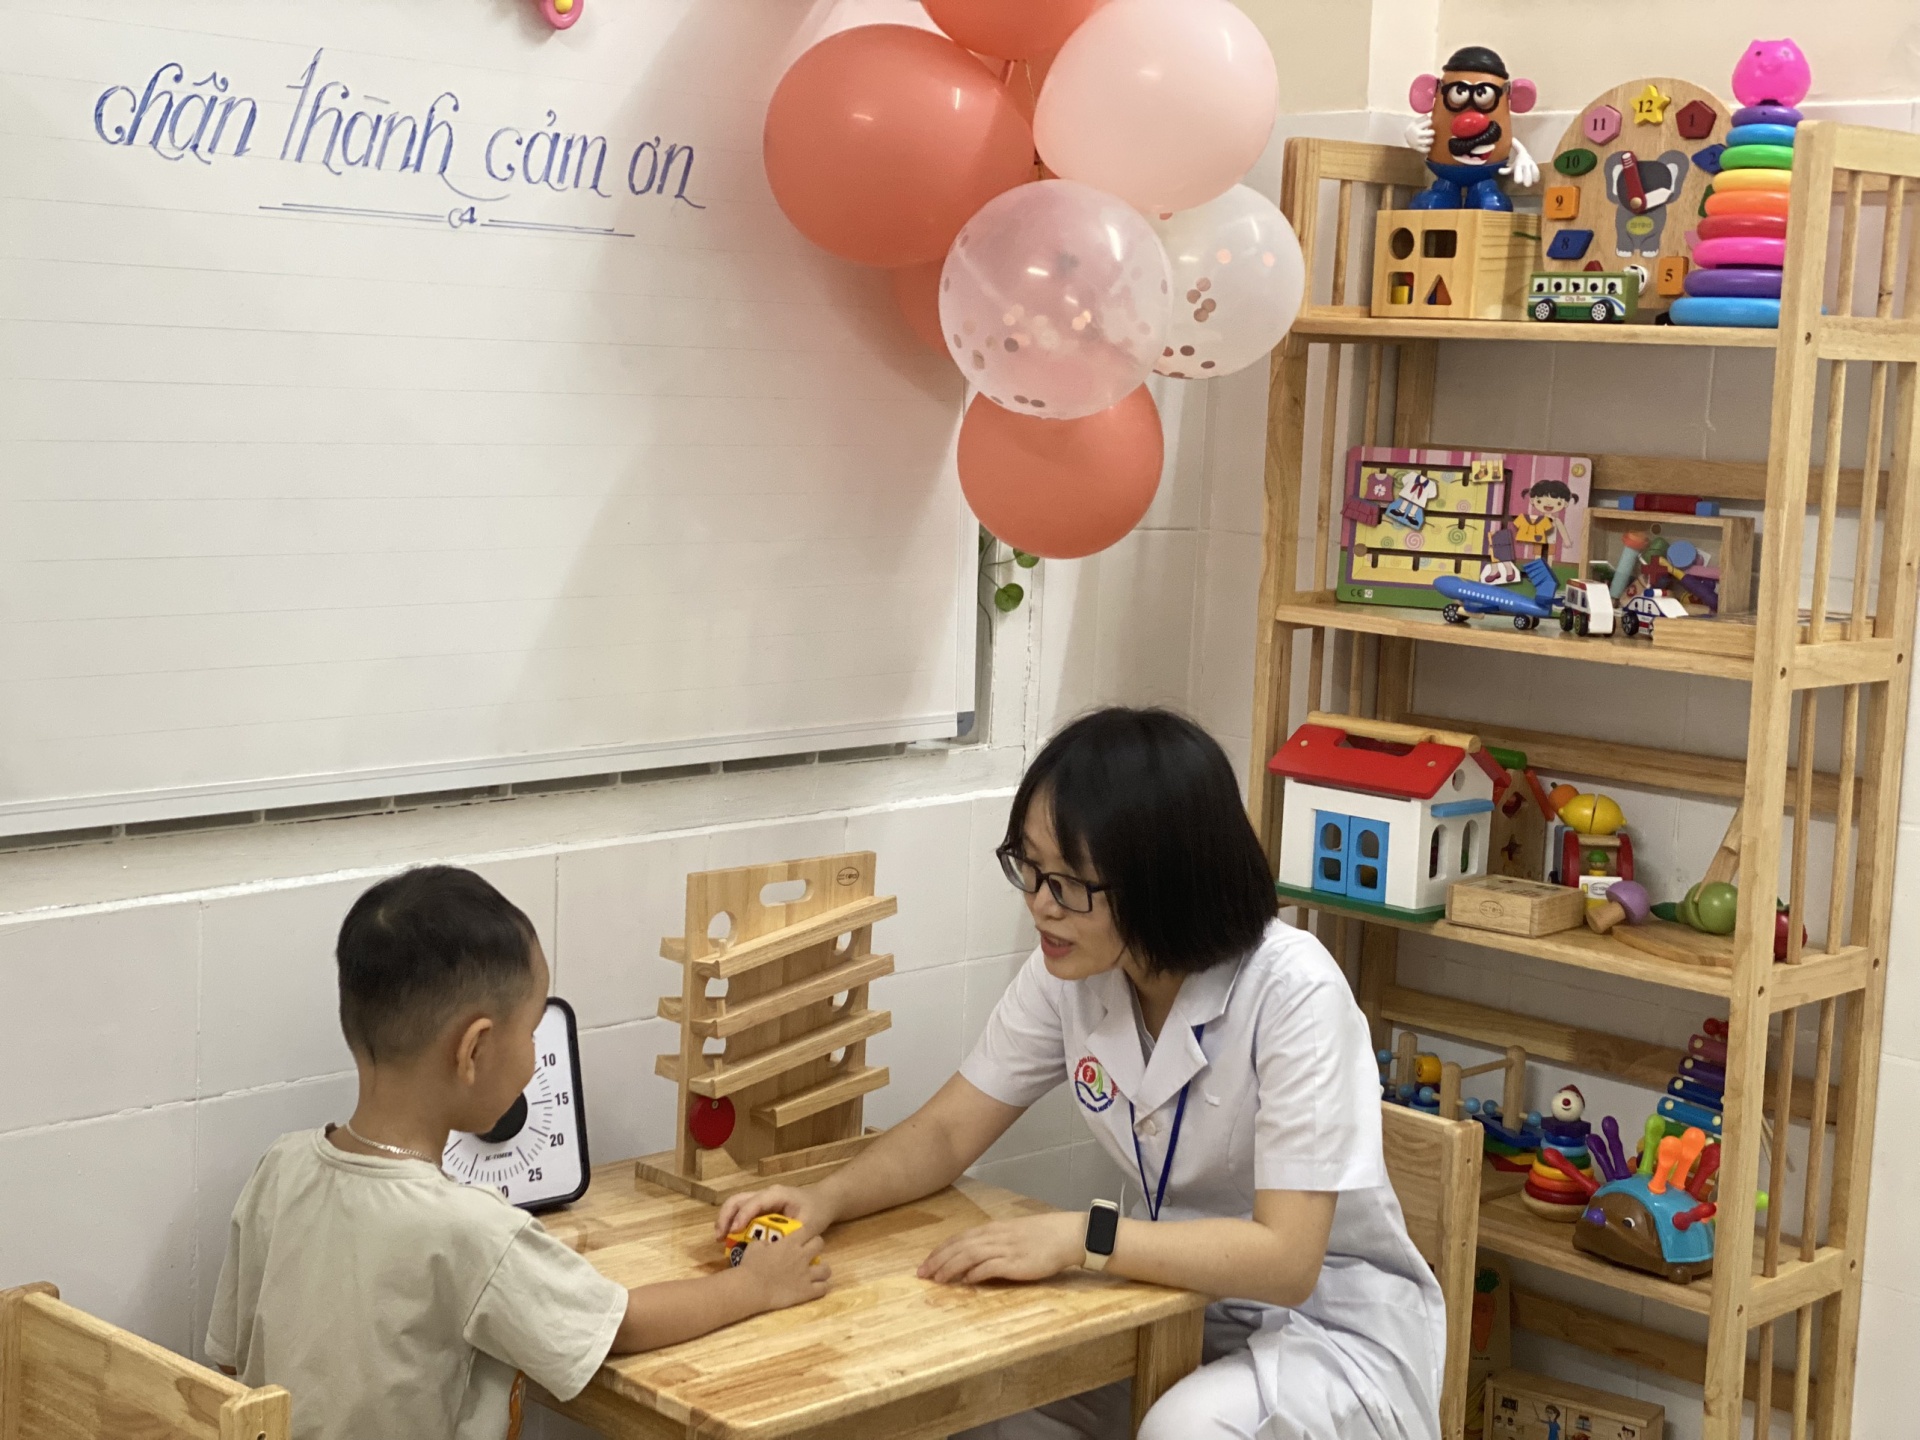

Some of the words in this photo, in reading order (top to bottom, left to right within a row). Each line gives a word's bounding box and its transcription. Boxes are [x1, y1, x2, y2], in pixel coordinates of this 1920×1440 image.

[1638, 100, 1653, 113] 12
[1593, 118, 1606, 131] 11
[1689, 114, 1695, 127] 1
[485, 109, 612, 198] cảm
[628, 136, 706, 209] ơn
[1565, 154, 1580, 169] 10
[1555, 195, 1564, 208] 9
[1561, 237, 1570, 251] 8
[1664, 268, 1673, 282] 5
[541, 1053, 556, 1067] 10
[555, 1091, 569, 1106] 15
[549, 1132, 564, 1148] 20
[528, 1167, 543, 1183] 25
